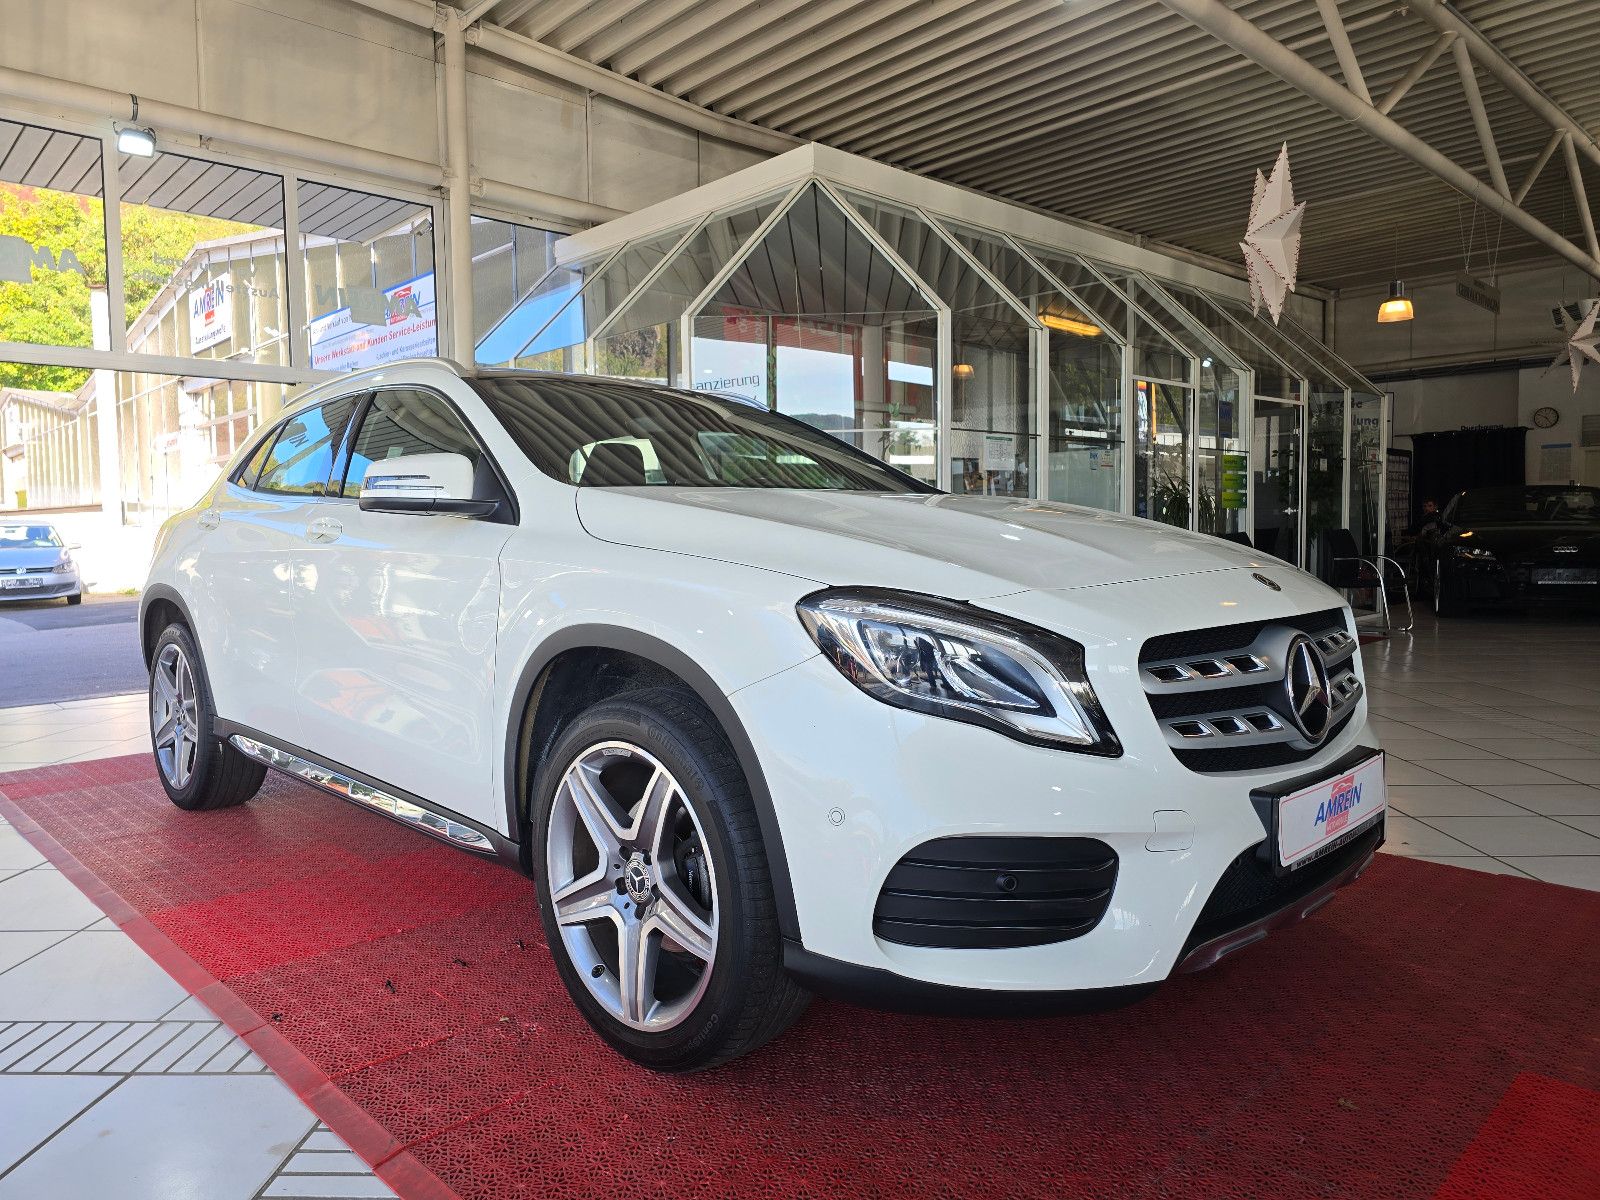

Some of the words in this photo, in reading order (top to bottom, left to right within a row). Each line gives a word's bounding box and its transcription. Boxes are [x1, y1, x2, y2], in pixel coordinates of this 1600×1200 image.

[388, 318, 436, 341] Service-Leistun
[696, 375, 760, 390] anzierung
[1314, 783, 1363, 827] AMREIN
